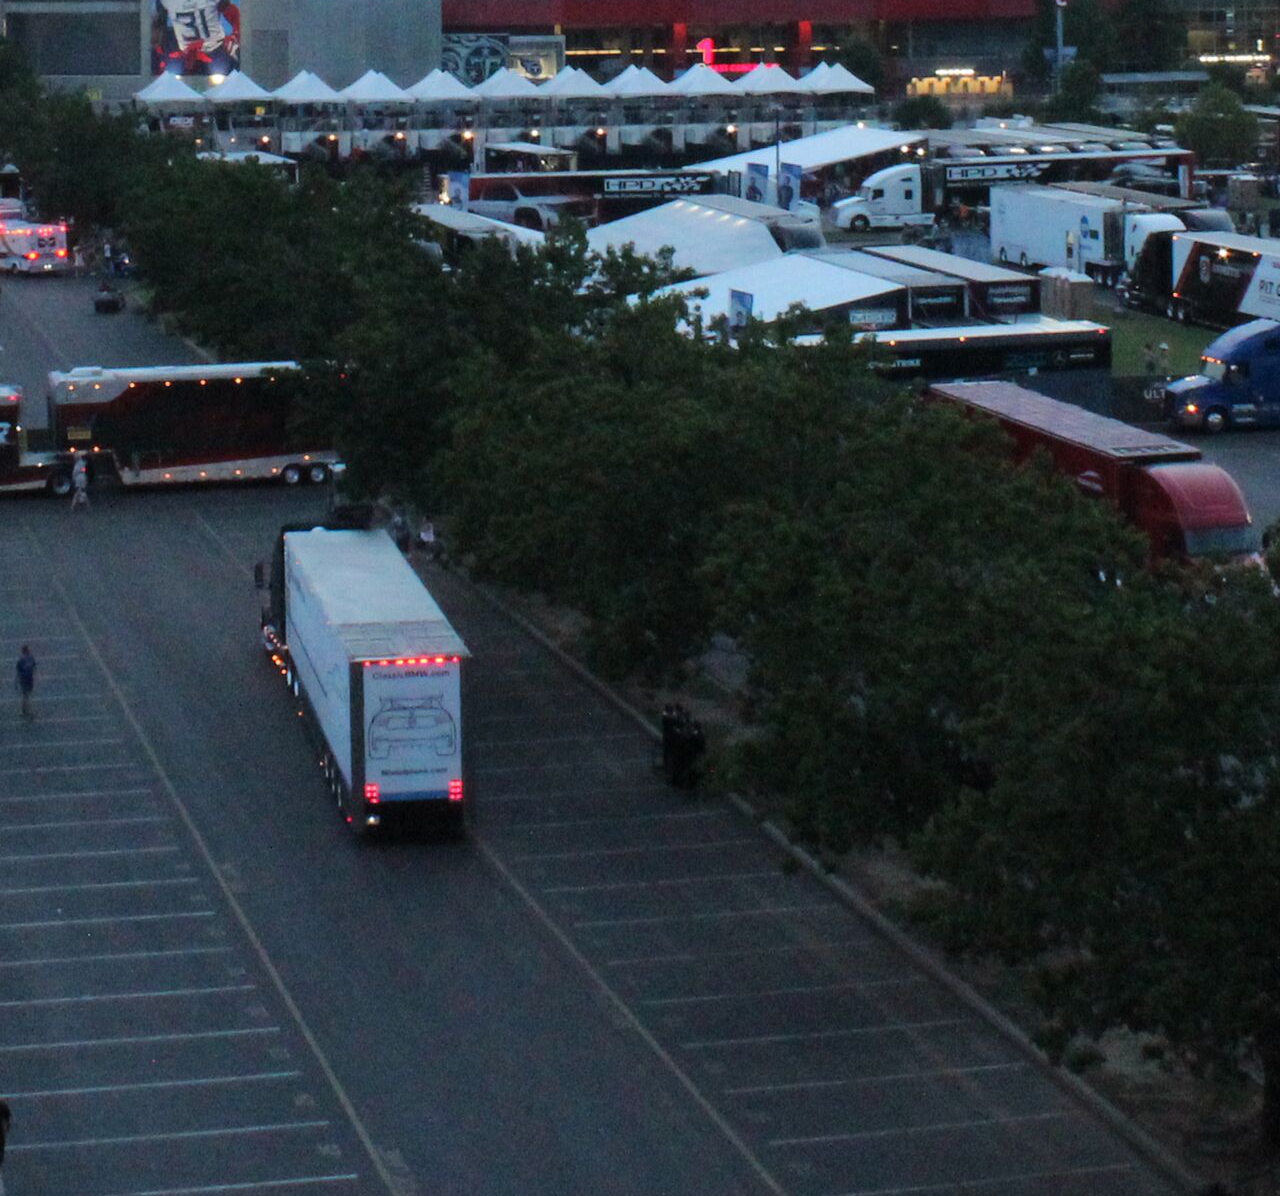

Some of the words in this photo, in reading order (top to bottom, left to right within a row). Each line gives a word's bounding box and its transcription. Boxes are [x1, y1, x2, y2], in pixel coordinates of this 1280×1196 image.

[176, 10, 211, 41] 31
[947, 166, 998, 179] HPD
[606, 180, 656, 192] HPD
[1259, 279, 1274, 295] PIT
[1144, 387, 1167, 401] ULT
